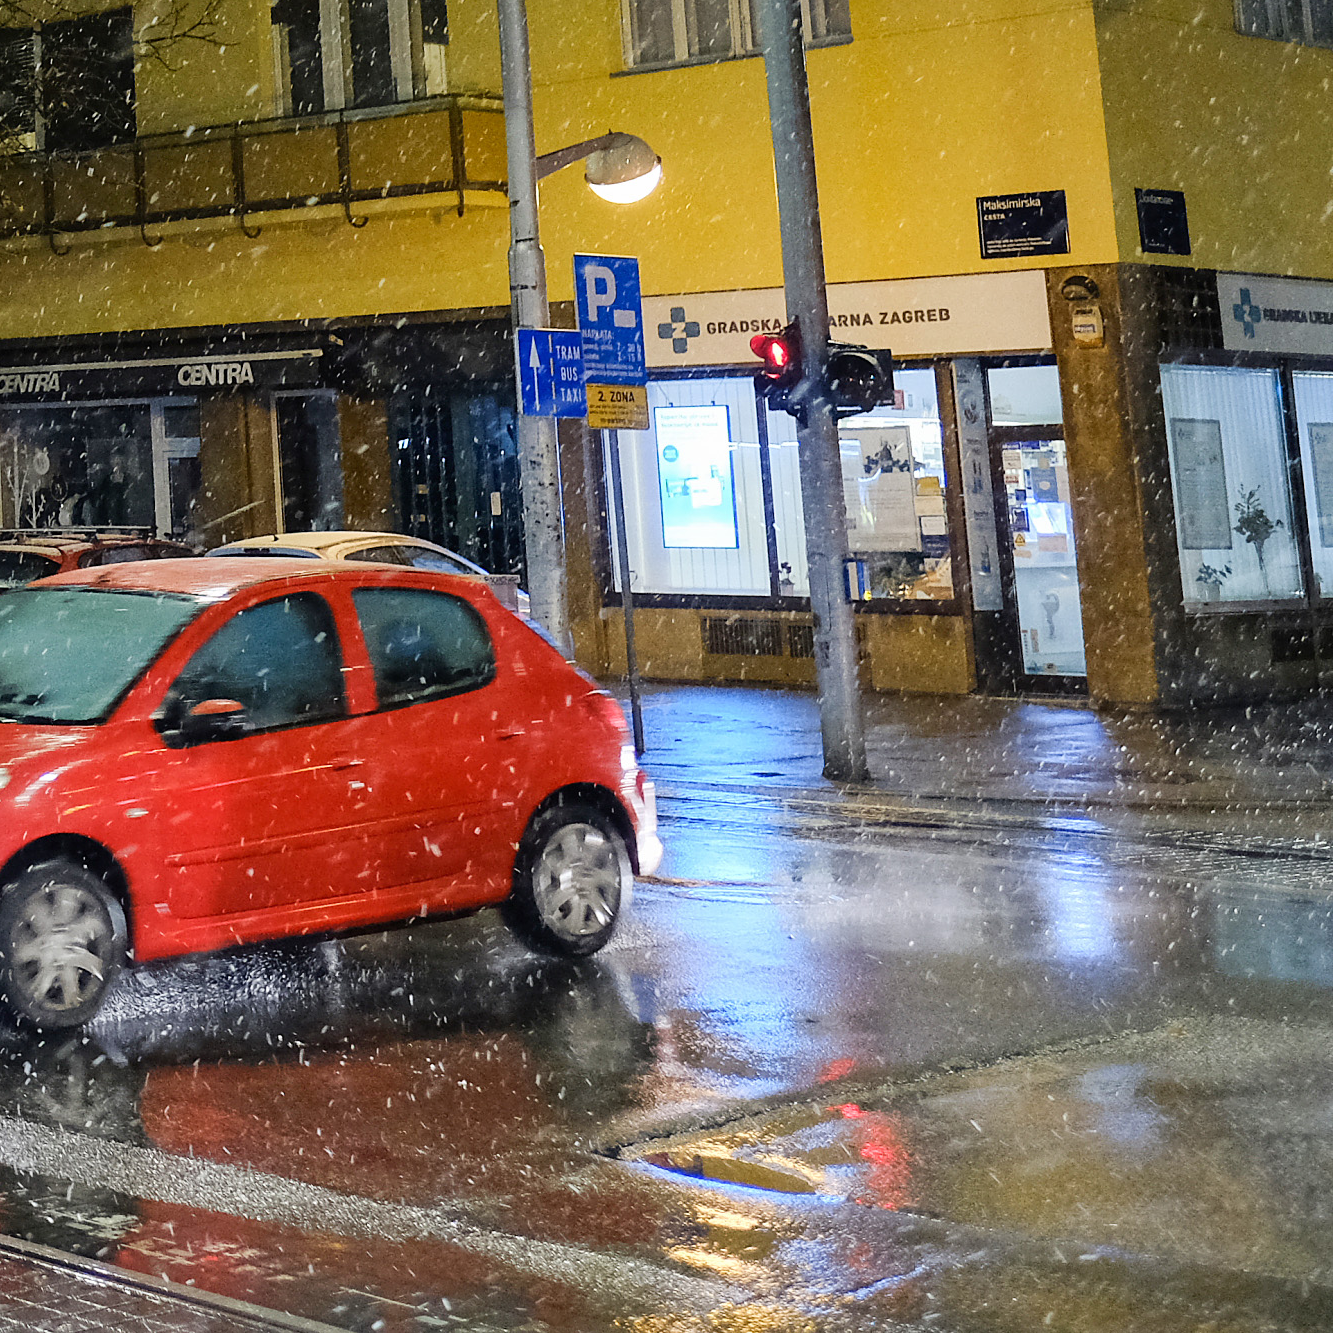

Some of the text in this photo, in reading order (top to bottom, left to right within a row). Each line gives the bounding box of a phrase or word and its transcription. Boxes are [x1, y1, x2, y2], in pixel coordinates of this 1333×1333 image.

[983, 197, 1041, 211] Maksimirska
[984, 213, 1006, 221] CESTA
[584, 265, 617, 322] P
[706, 318, 782, 335] GRADSKA
[879, 308, 951, 325] ZAGREB
[556, 345, 581, 360] TRAM
[178, 362, 255, 386] CENTRA
[560, 367, 578, 381] BUS
[560, 388, 582, 403] TAXI
[610, 391, 635, 403] ZONA
